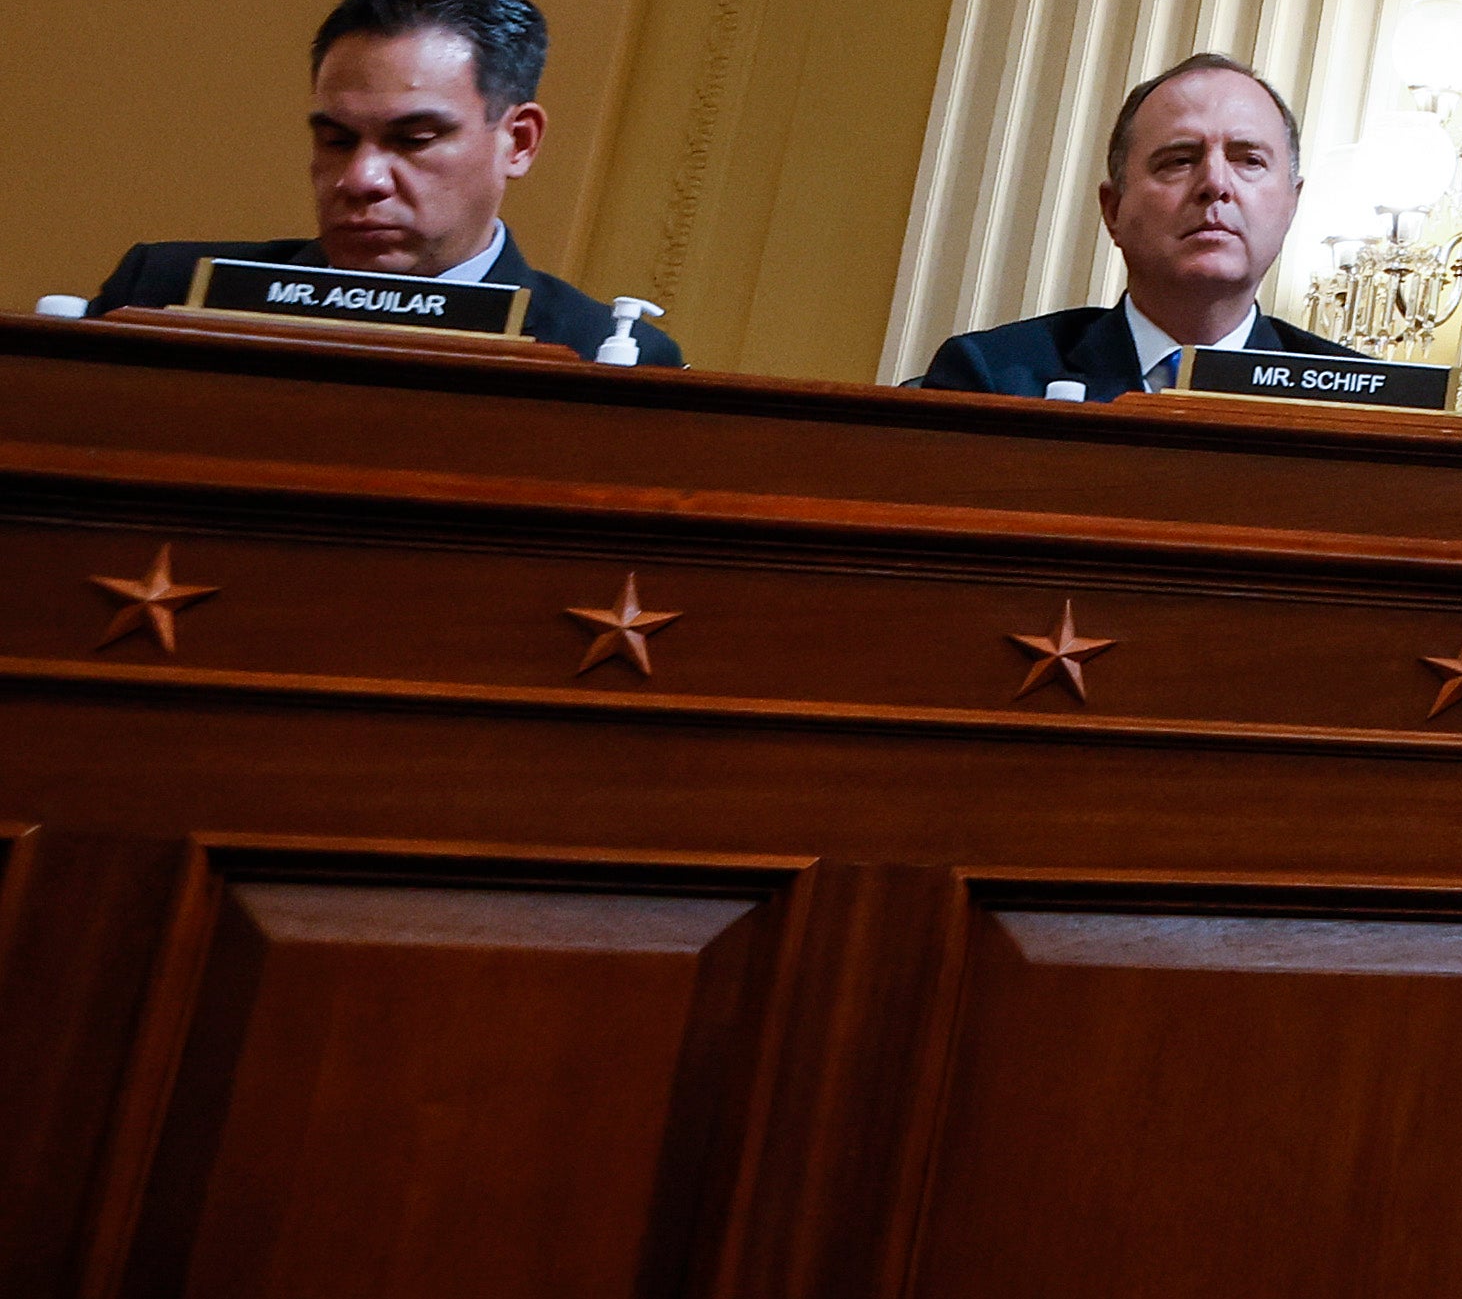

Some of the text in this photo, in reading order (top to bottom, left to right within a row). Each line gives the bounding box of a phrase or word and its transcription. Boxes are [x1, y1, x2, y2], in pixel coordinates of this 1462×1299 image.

[266, 280, 447, 316] MR. AGUILAR
[1252, 365, 1386, 394] MR. SCHIFF
